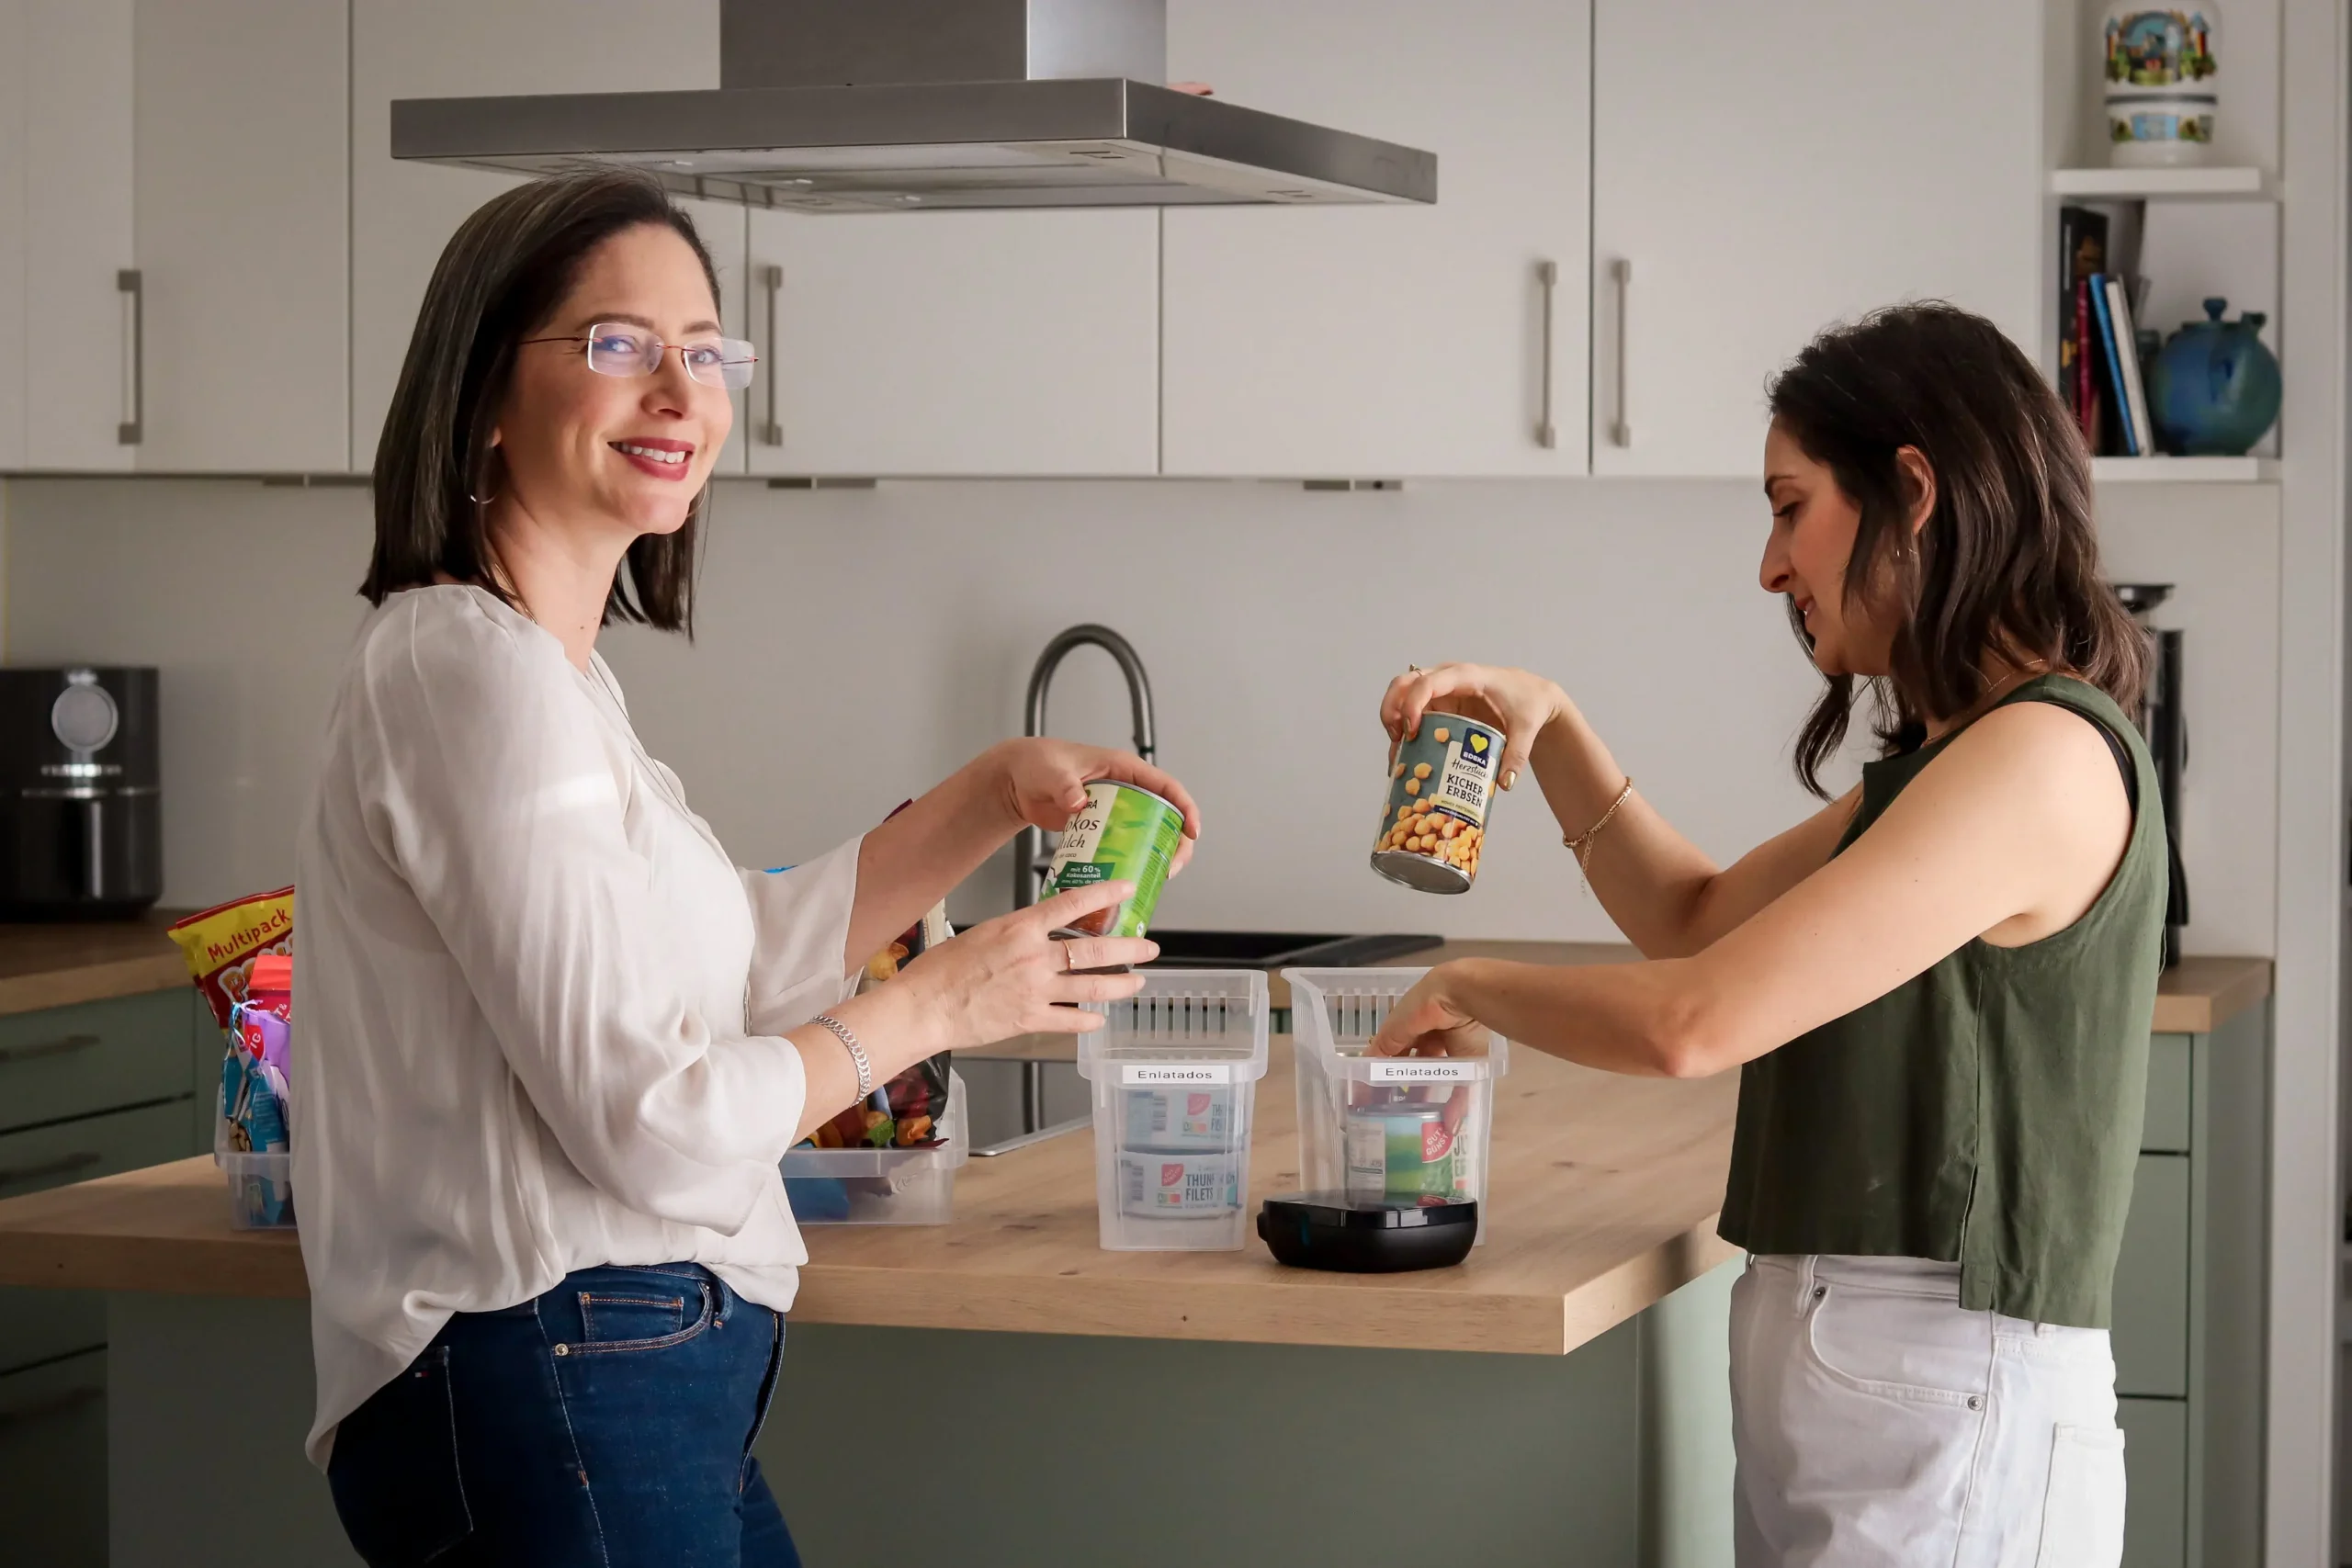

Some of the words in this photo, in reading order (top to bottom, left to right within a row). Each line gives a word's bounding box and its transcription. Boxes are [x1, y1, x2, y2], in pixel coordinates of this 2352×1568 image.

[1463, 751, 1486, 766] EDEKA
[1446, 785, 1483, 808] ERBSEN
[1063, 812, 1100, 834] okos
[207, 908, 291, 963] Multipack
[1137, 1070, 1213, 1079] Enlatados
[1385, 1067, 1459, 1077] Enlatados
[1426, 1134, 1449, 1156] GÜNST
